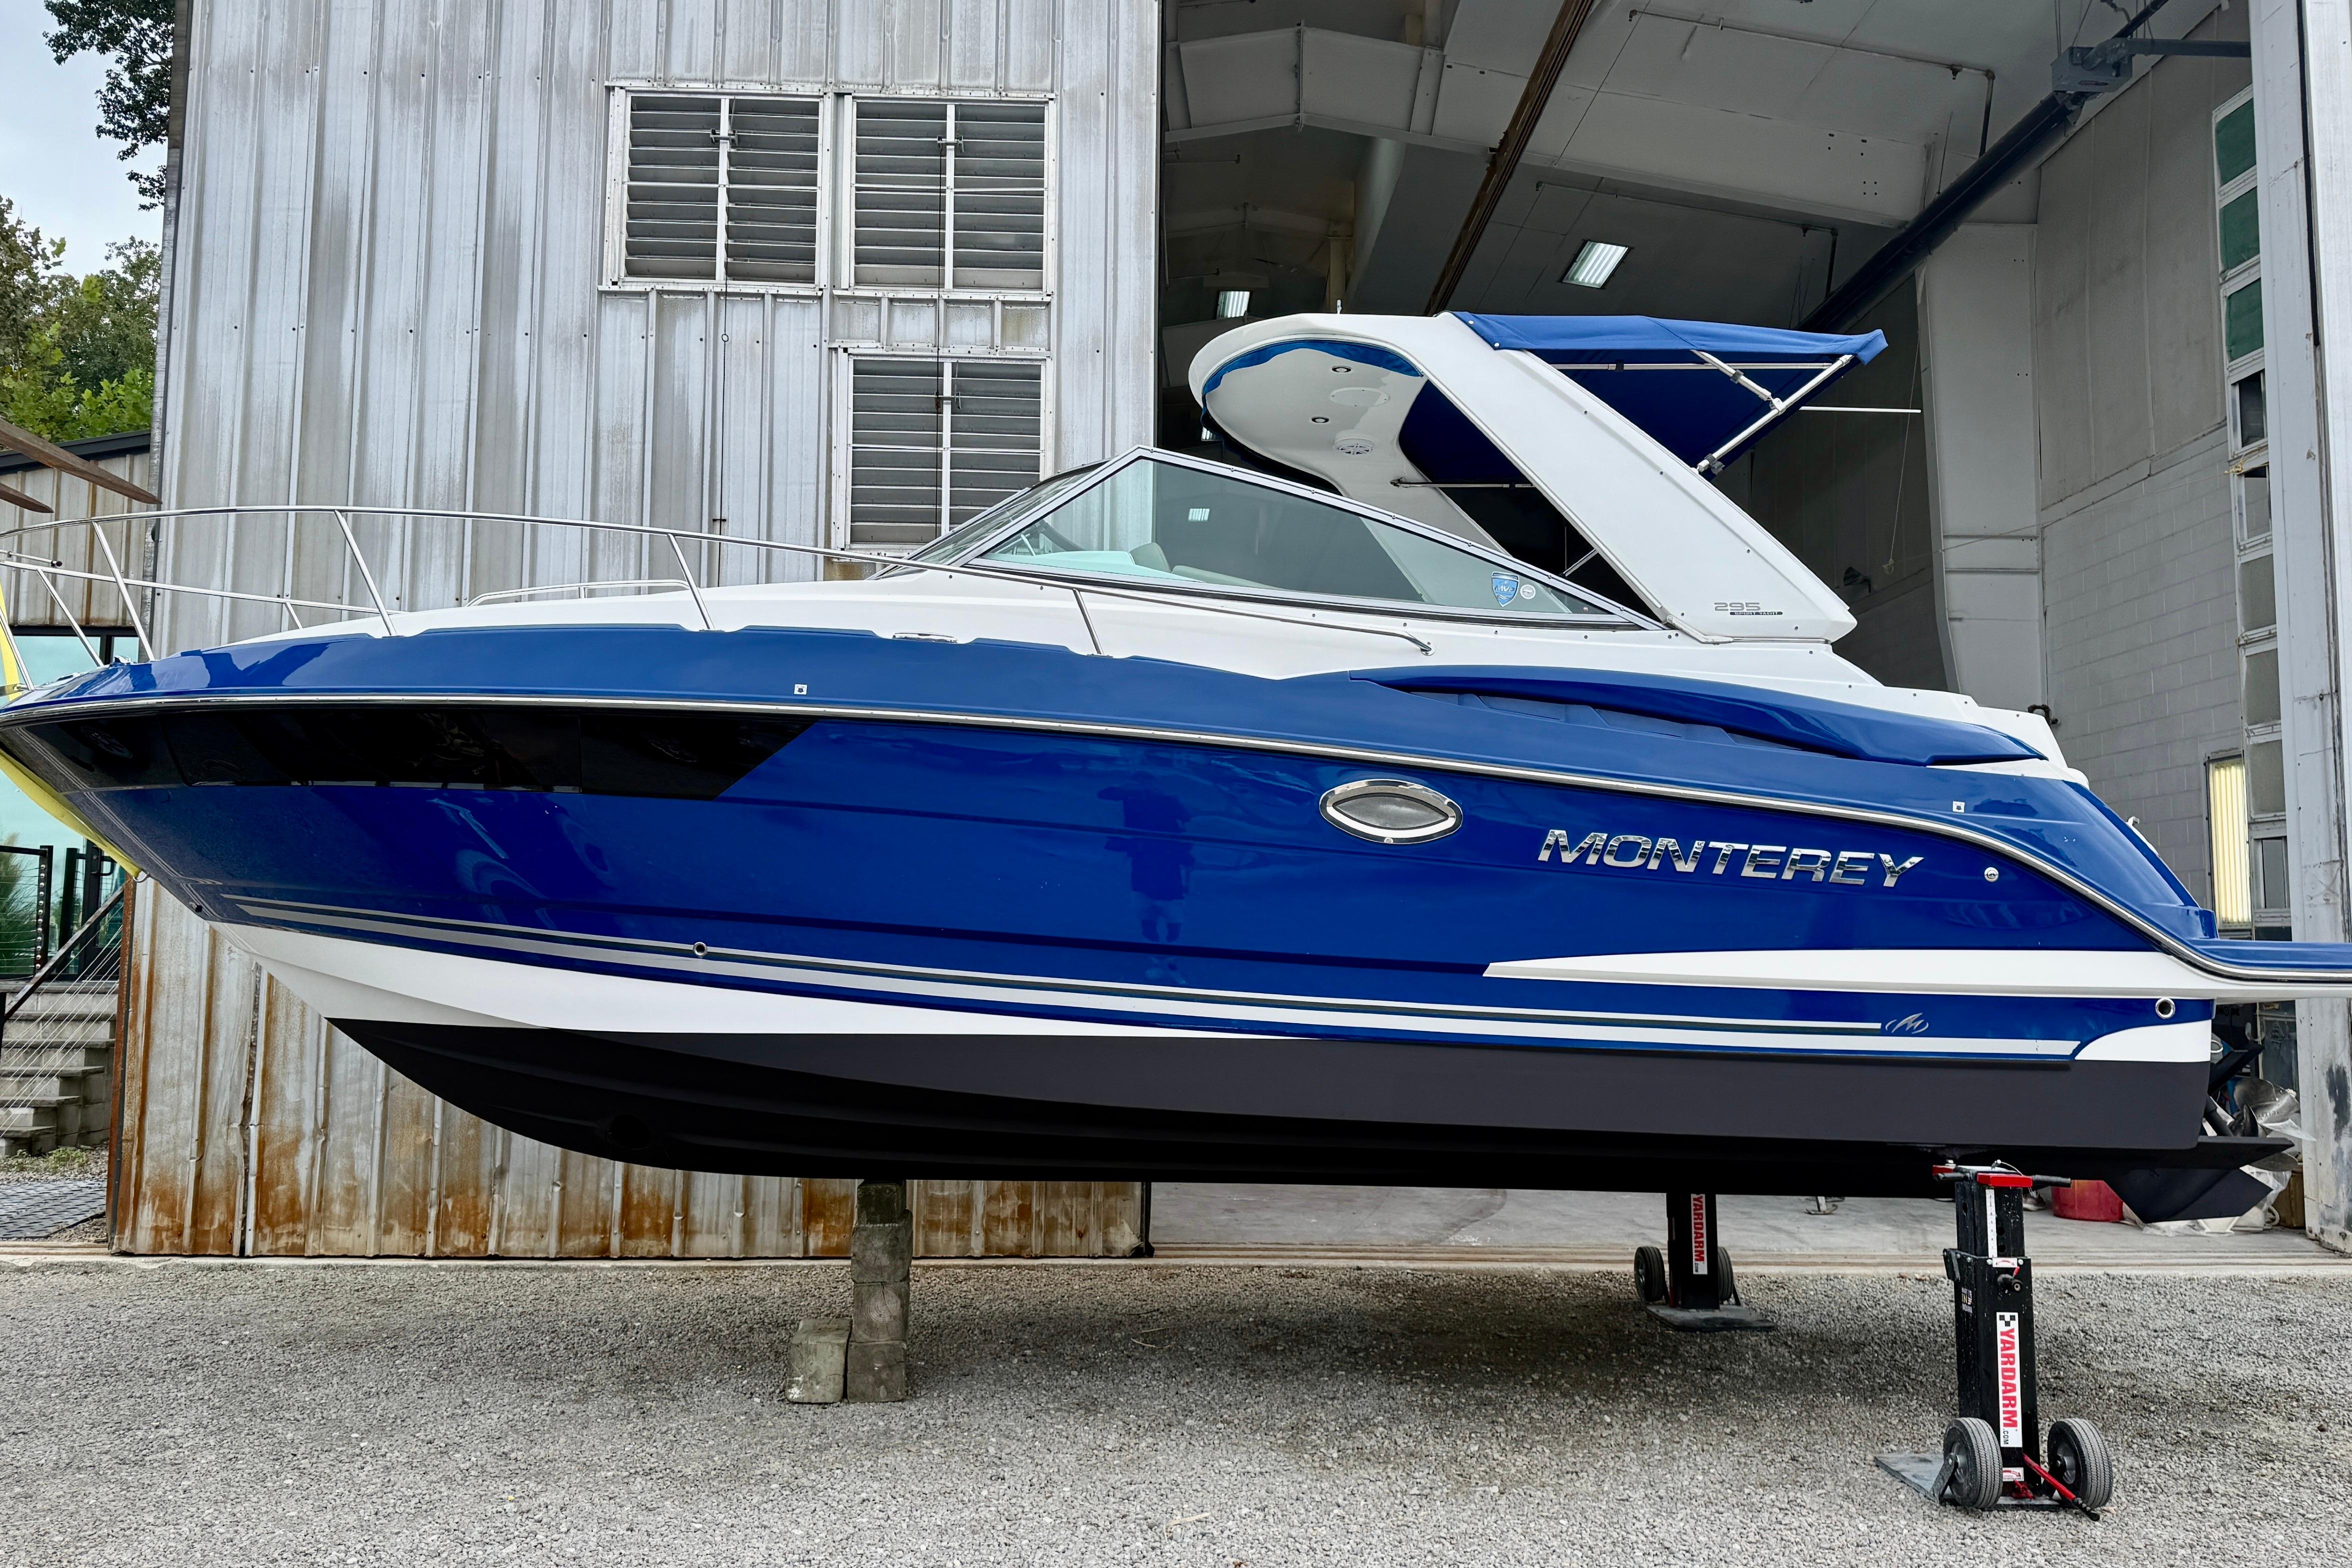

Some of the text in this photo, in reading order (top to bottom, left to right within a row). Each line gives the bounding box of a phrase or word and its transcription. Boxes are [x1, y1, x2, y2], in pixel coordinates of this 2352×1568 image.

[1714, 602, 1761, 611] 295
[1538, 829, 1925, 888] MONTEREY
[1693, 1195, 1705, 1262] YARDARM
[2000, 1328, 2018, 1428] YARDARM
